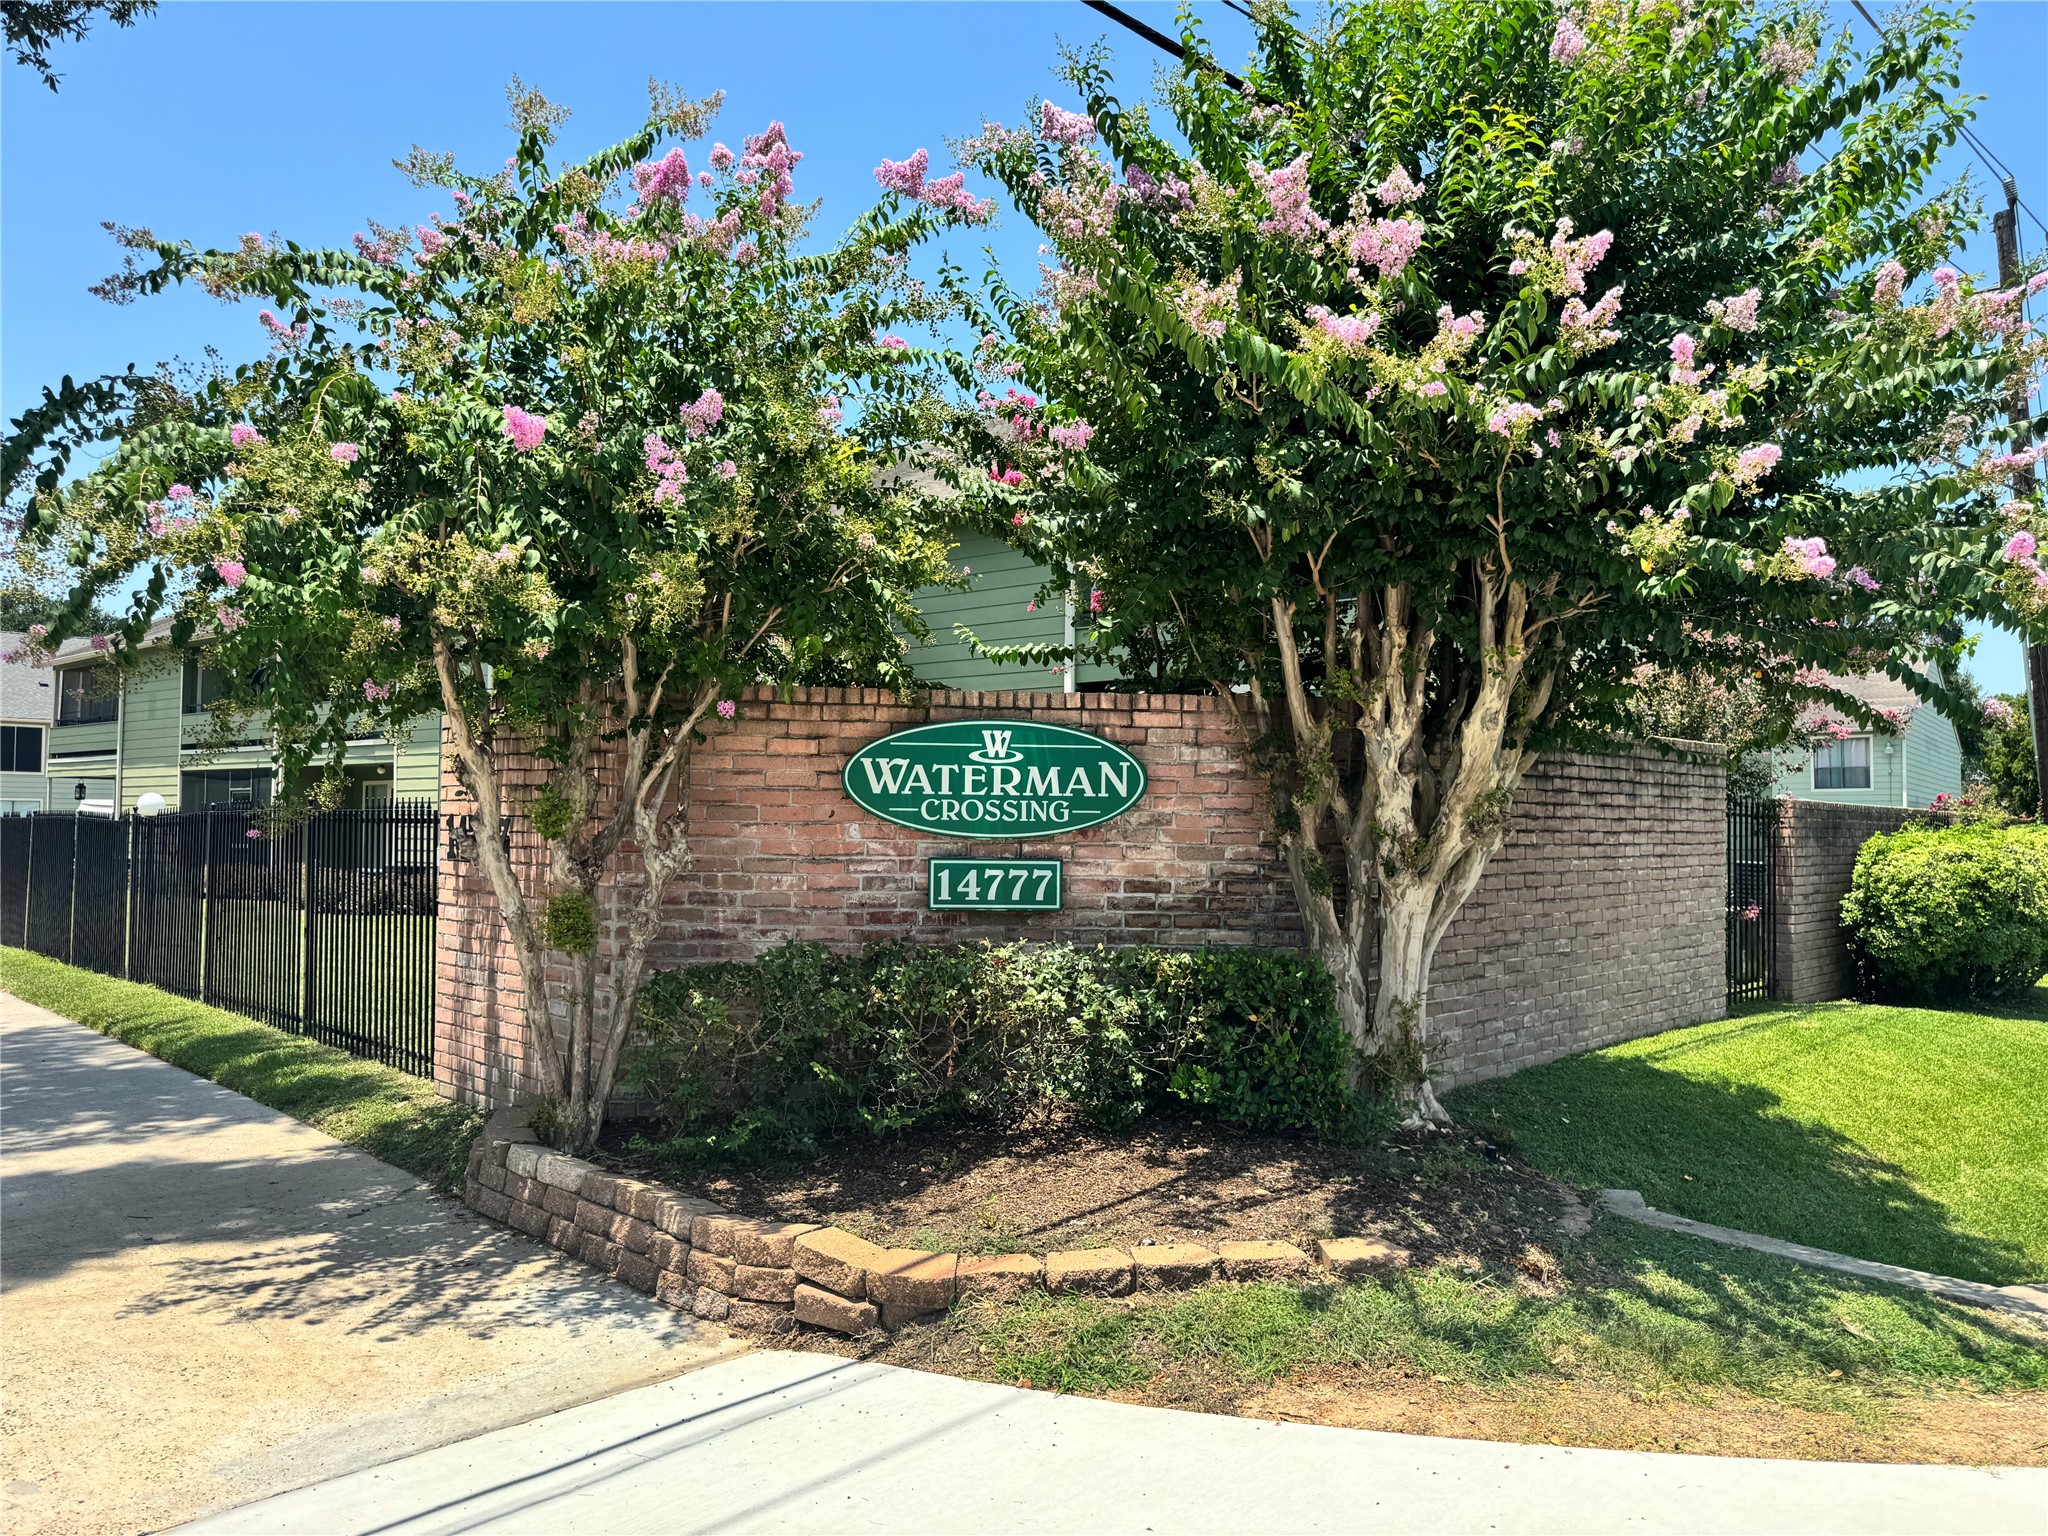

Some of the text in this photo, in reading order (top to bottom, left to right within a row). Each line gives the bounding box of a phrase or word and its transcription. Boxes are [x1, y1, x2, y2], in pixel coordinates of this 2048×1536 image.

[860, 758, 1130, 797] WATERMAN
[920, 799, 1070, 822] CROSSING
[937, 869, 1053, 900] 14777
